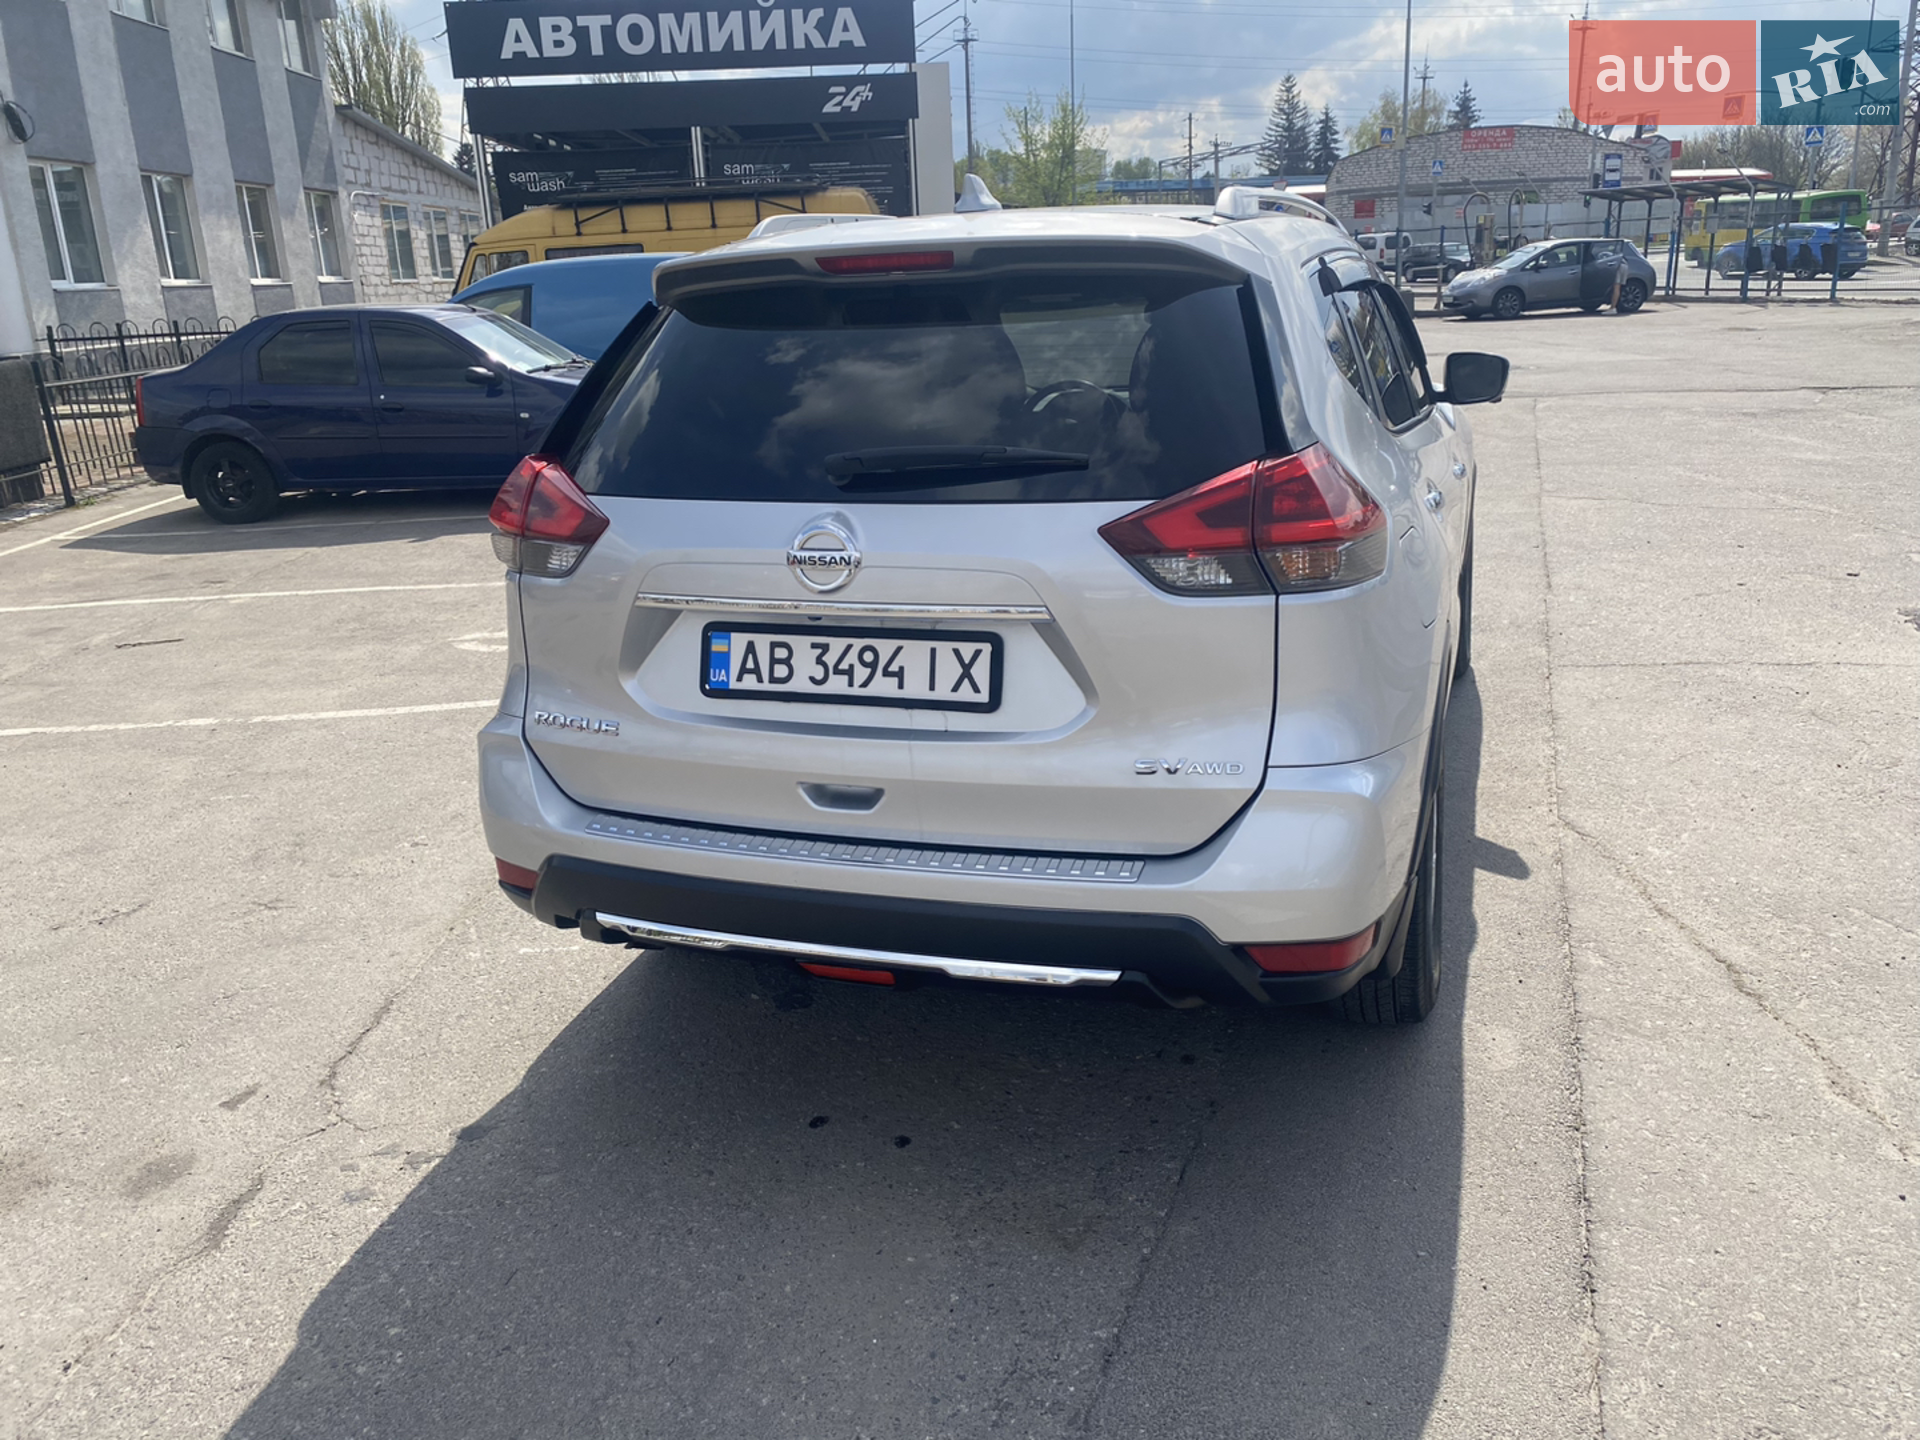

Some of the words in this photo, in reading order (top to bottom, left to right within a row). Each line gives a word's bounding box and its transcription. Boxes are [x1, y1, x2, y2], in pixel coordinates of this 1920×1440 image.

[500, 0, 867, 60] АВТОМИЙКА
[1470, 129, 1507, 137] ОРЕНДА
[723, 163, 754, 175] sam
[508, 171, 539, 183] sam
[527, 178, 566, 192] wash
[792, 555, 852, 567] NISSAN
[736, 640, 794, 685] AB
[808, 642, 905, 690] 3494
[928, 646, 984, 694] IX
[709, 669, 728, 682] UA
[534, 710, 620, 737] ROGUE
[1134, 758, 1187, 775] SV
[1186, 762, 1245, 775] AWD
